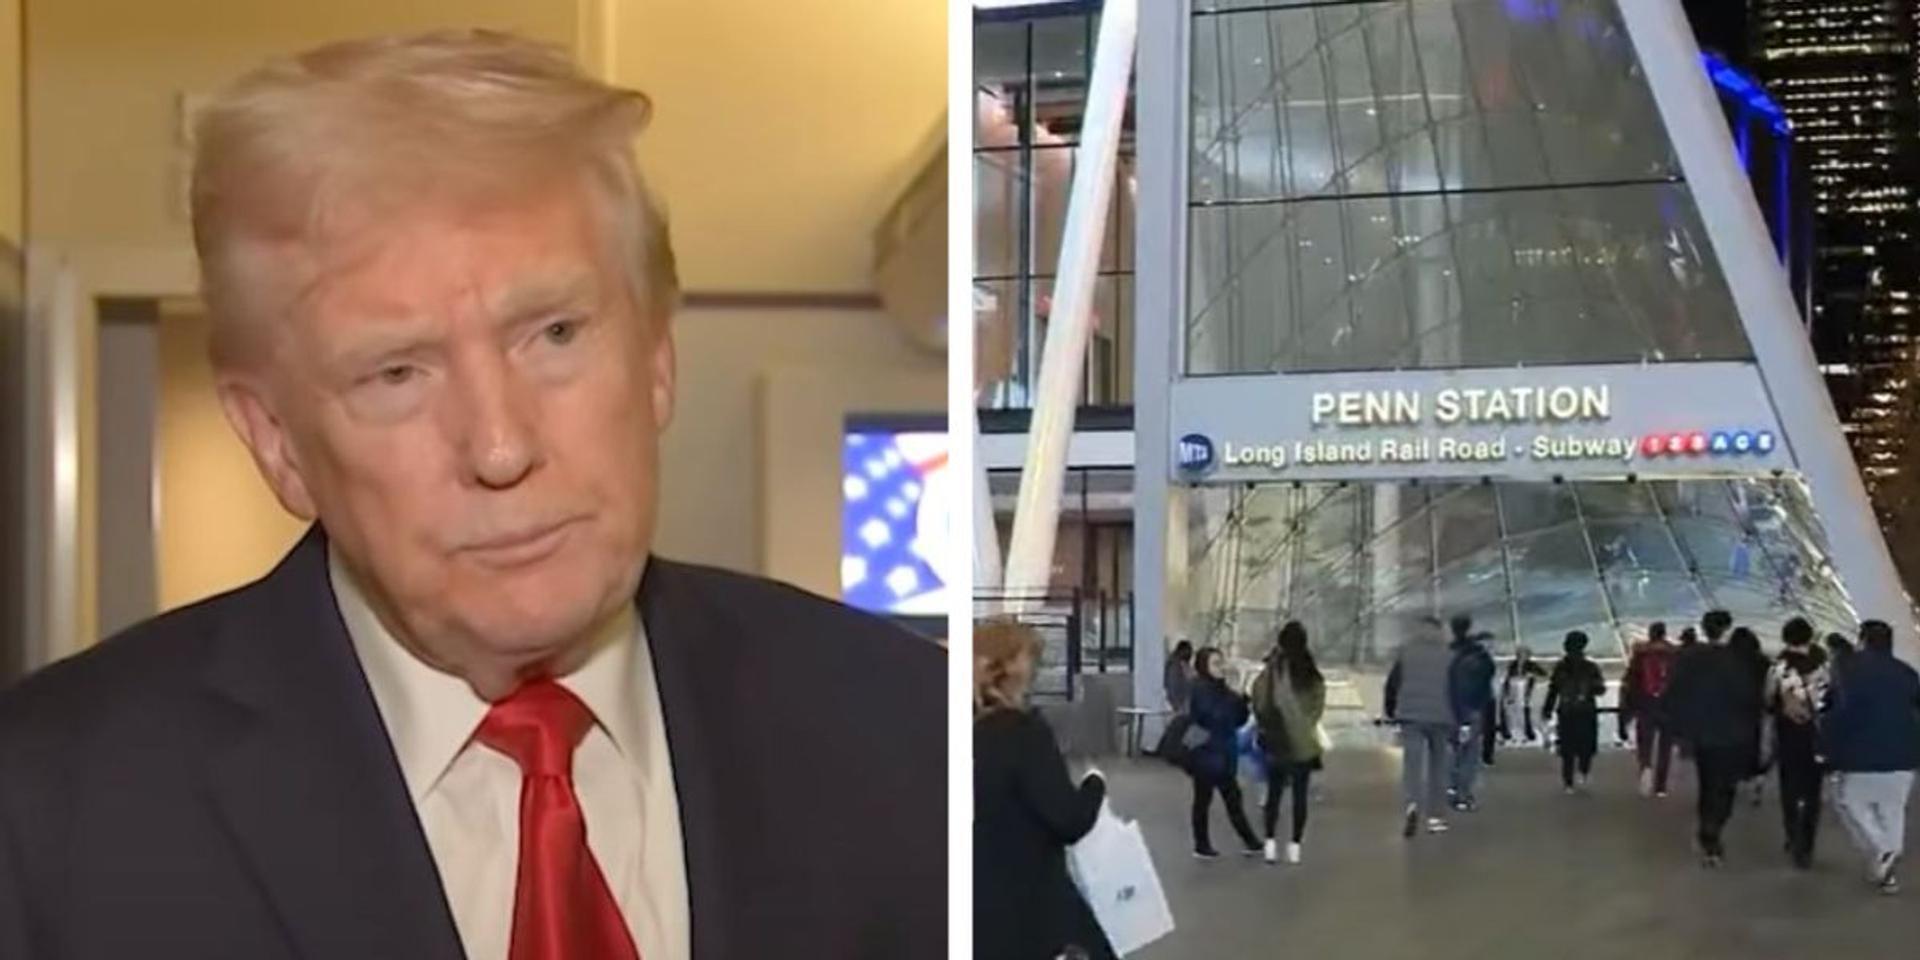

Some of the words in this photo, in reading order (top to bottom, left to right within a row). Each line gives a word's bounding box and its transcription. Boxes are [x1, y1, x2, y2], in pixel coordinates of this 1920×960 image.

[1312, 390, 1420, 424] PENN
[1435, 385, 1610, 422] STATION
[1224, 441, 1285, 468] Long
[1294, 439, 1371, 463] Island
[1380, 438, 1430, 461] Rail
[1438, 436, 1506, 460] Road
[1532, 435, 1639, 460] Subway
